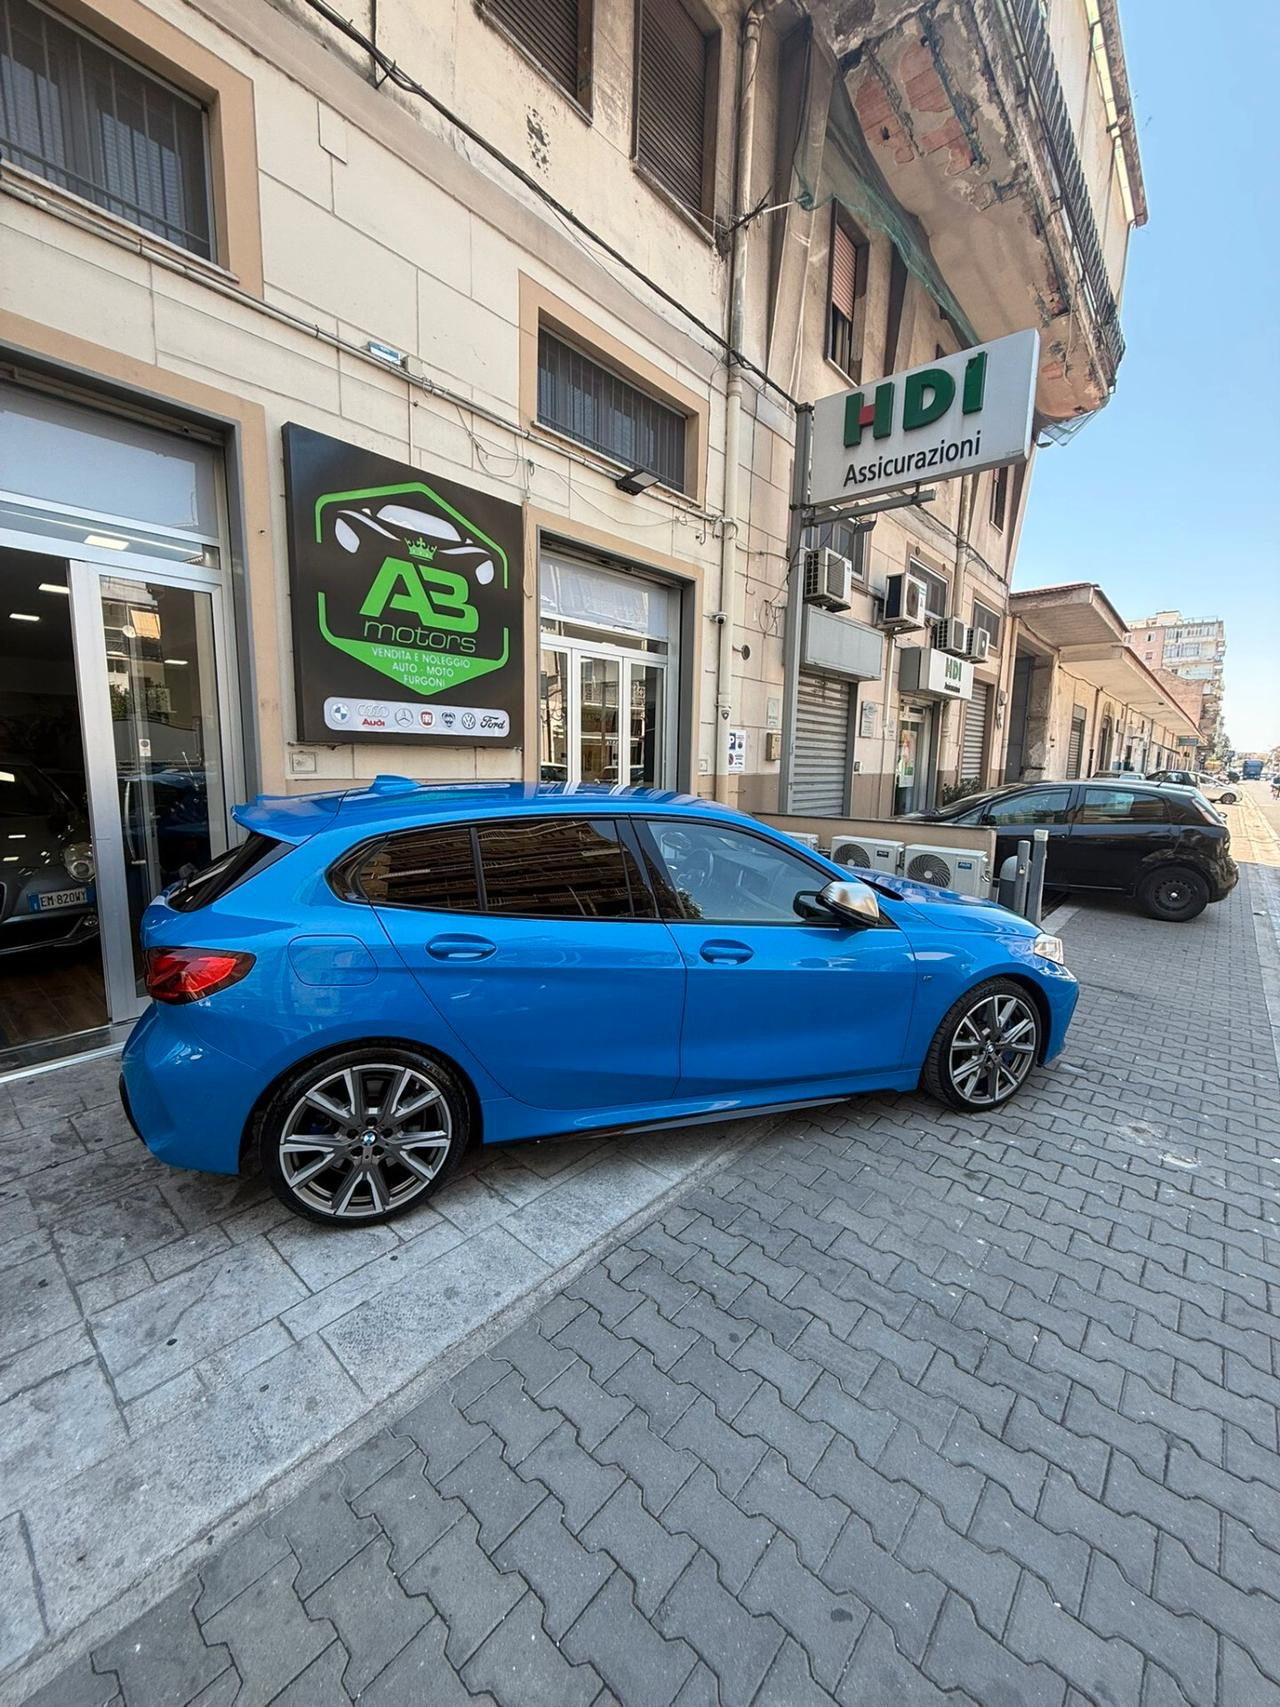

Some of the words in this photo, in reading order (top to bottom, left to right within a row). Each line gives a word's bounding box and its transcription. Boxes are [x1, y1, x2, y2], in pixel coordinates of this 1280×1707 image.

[843, 351, 988, 448] HDI
[843, 430, 982, 488] Assicurazioni
[360, 556, 479, 633] AB
[364, 620, 477, 653] motors
[371, 647, 412, 660] VENDITA
[414, 653, 420, 662] E
[422, 655, 471, 669] NOLEGGIO
[944, 656, 962, 681] HDI
[392, 662, 418, 673] AUTO
[426, 666, 454, 678] MOTO
[403, 674, 446, 688] FURGONI
[362, 718, 386, 727] Audi
[480, 715, 506, 729] Ford
[41, 895, 54, 907] EM
